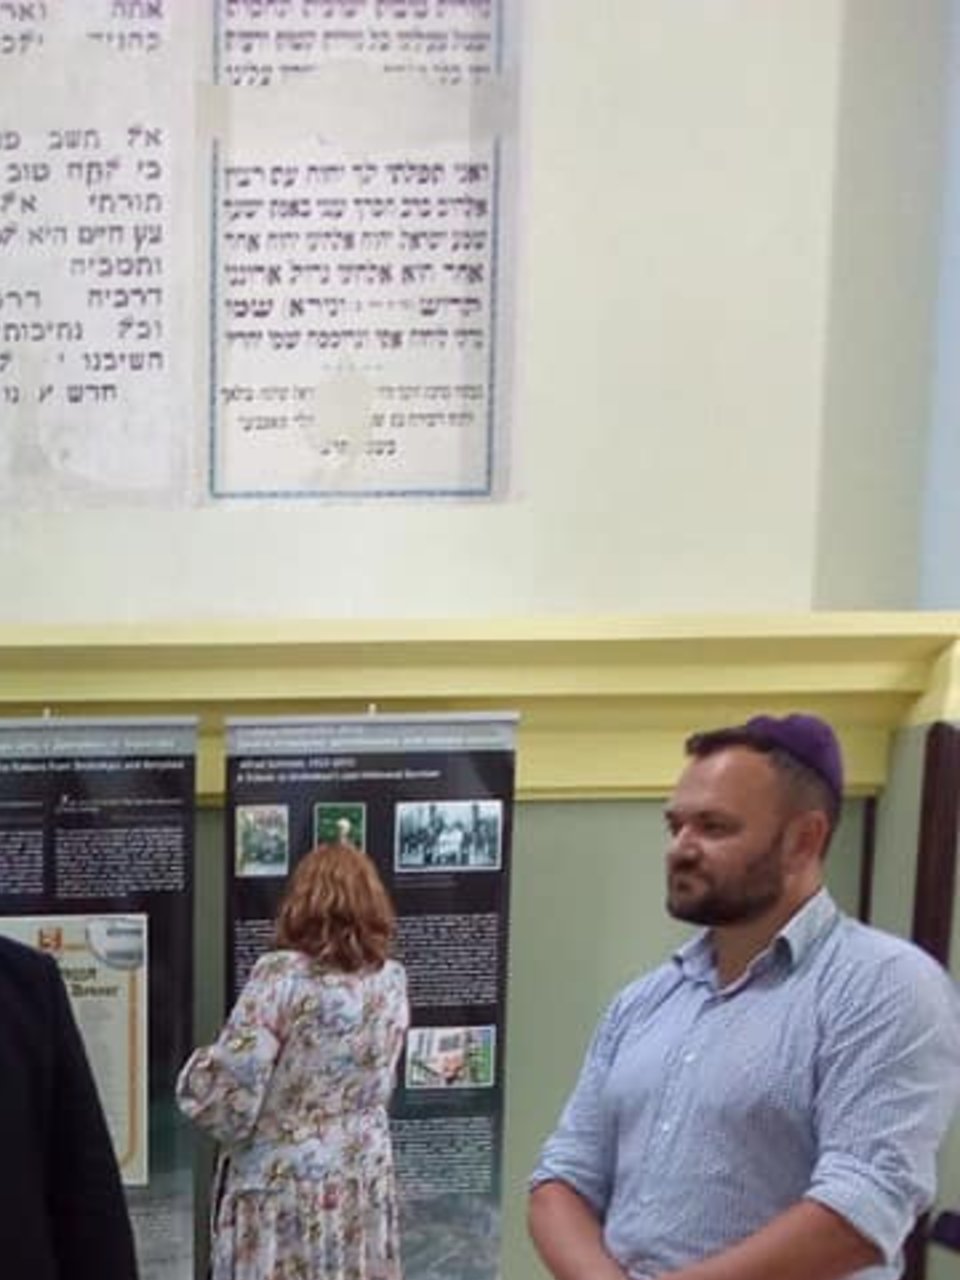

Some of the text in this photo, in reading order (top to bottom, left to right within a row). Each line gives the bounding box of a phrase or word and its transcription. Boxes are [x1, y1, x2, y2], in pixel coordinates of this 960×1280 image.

[6, 162, 51, 184] טוב
[137, 160, 162, 180] כי
[0, 190, 37, 214] אל
